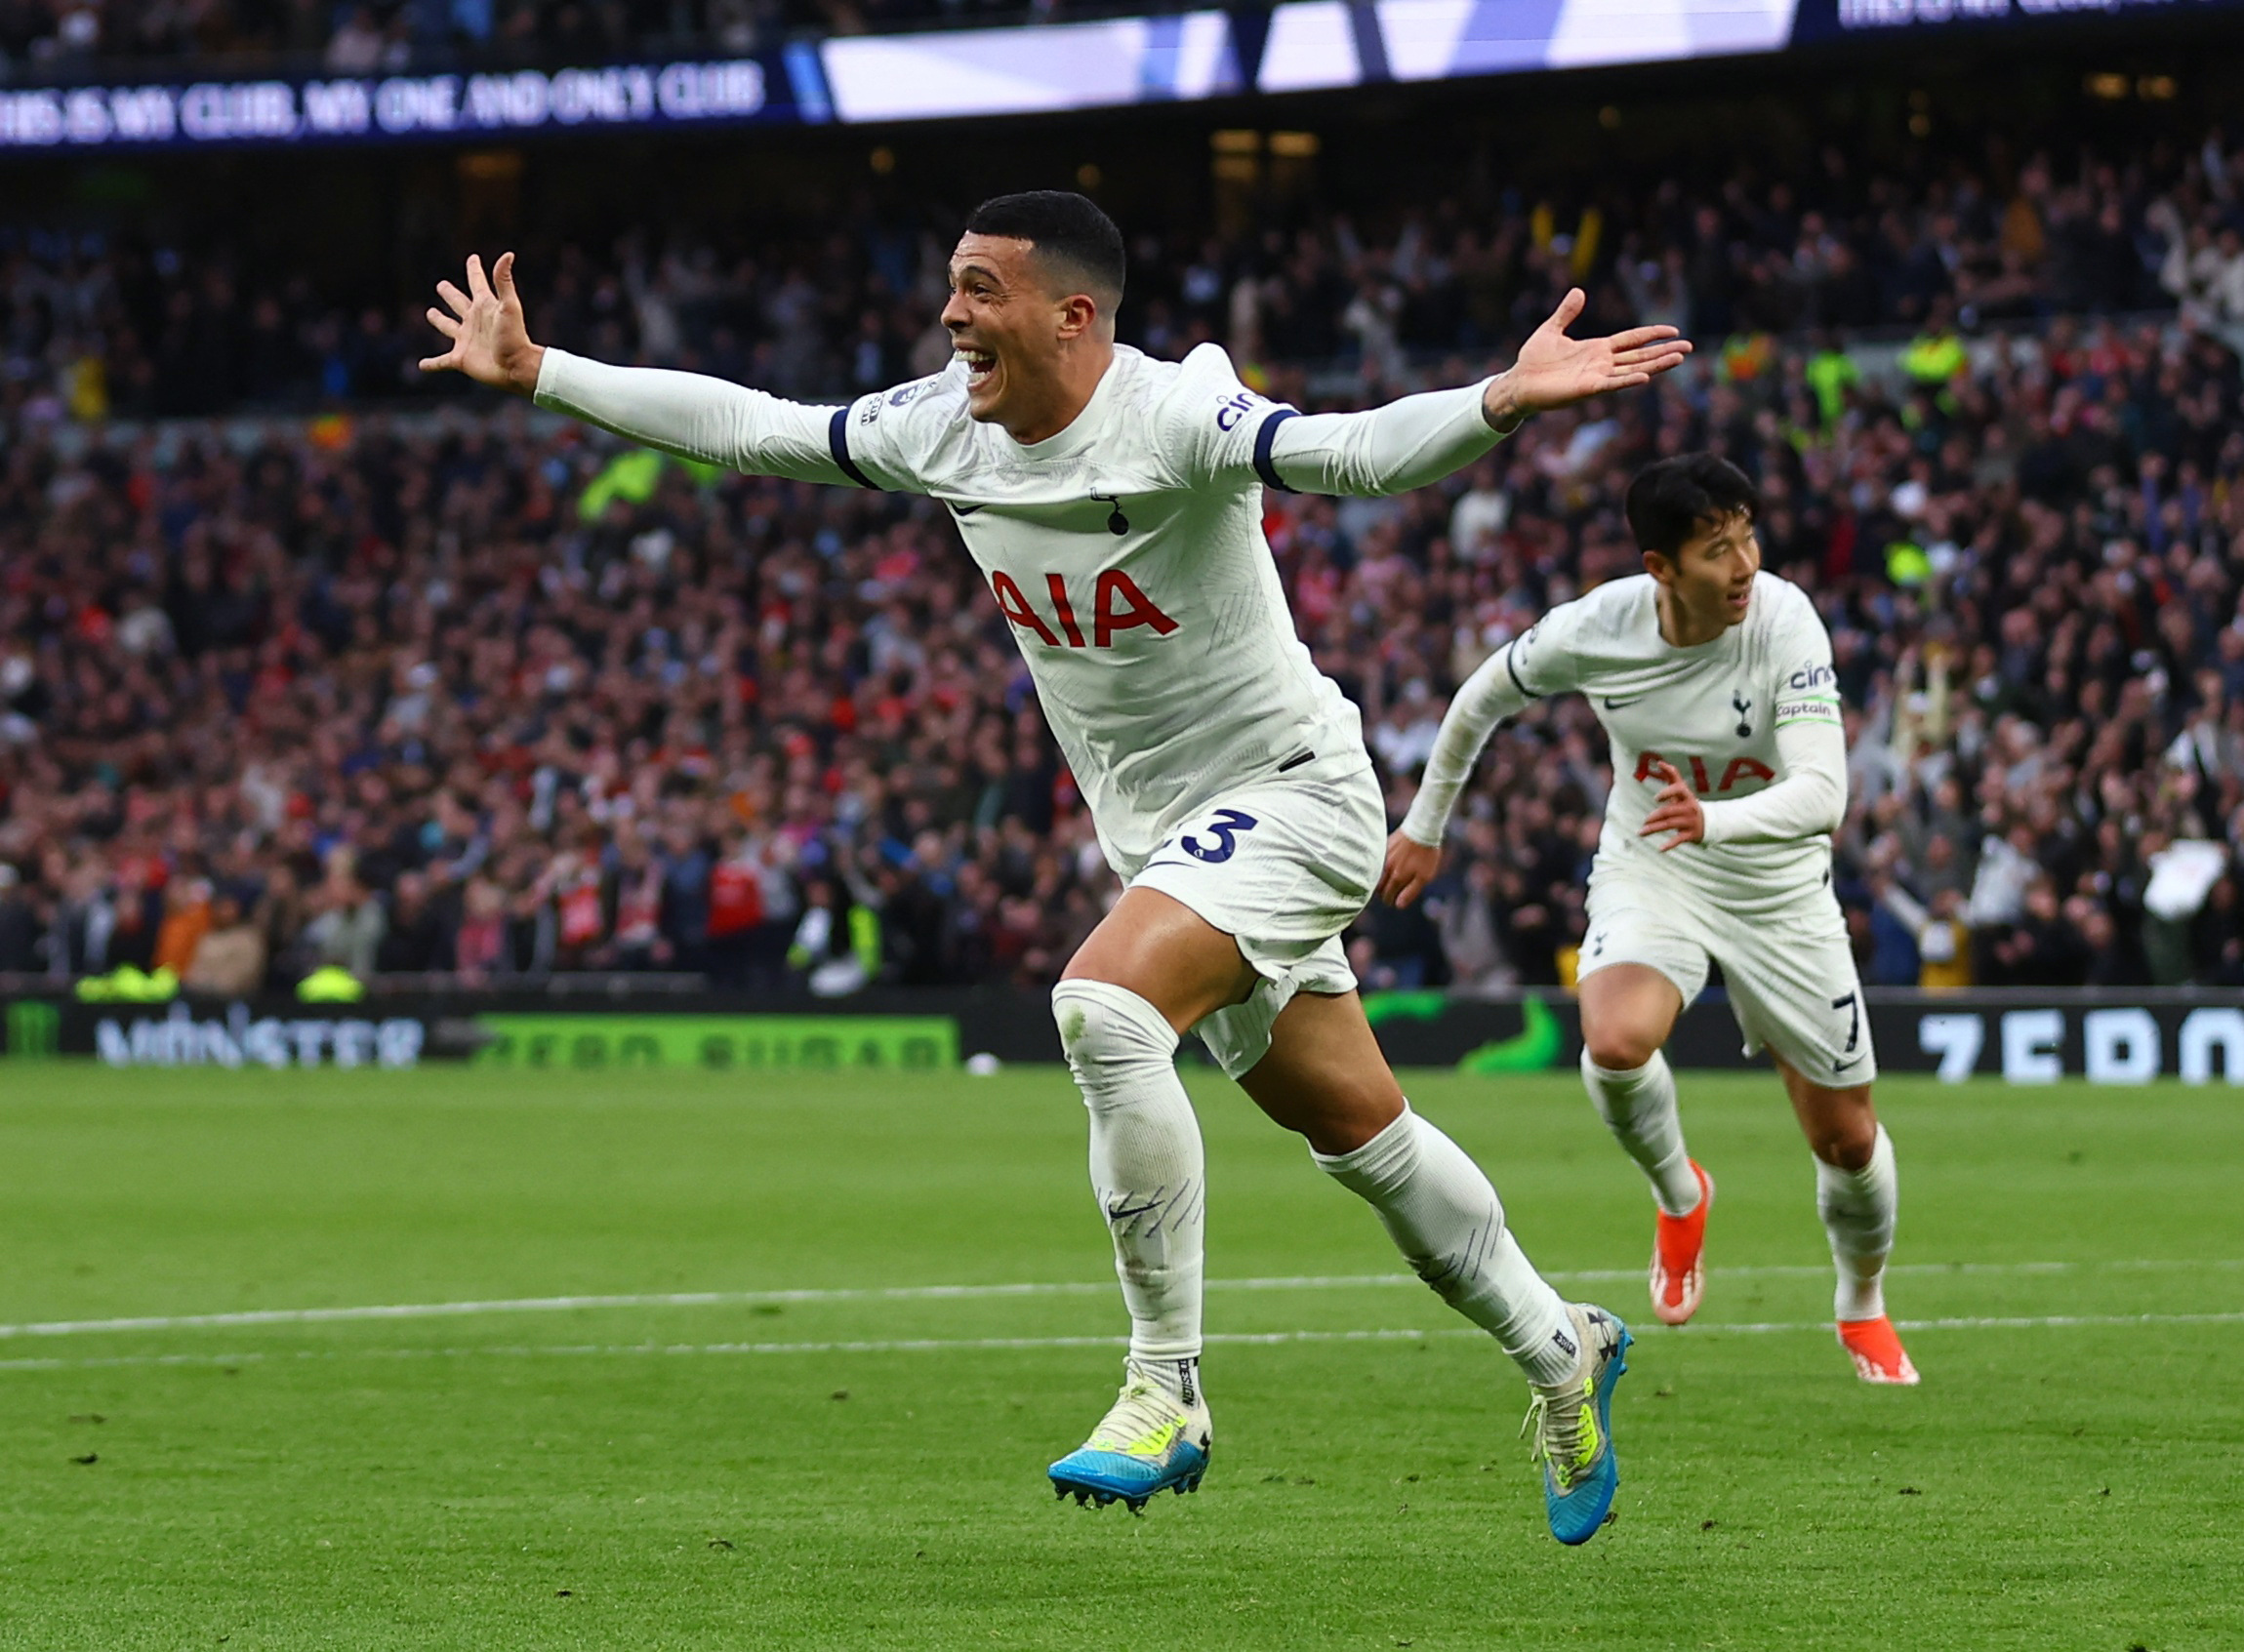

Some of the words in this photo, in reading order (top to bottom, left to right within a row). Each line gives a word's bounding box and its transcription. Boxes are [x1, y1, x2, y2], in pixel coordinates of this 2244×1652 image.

[109, 84, 178, 141] MY
[303, 78, 375, 134] MY
[375, 74, 461, 134] ONE
[461, 69, 551, 128] AND
[550, 65, 656, 125] ONLY
[657, 59, 765, 119] CLUB
[992, 569, 1180, 647] AIA
[1633, 751, 1775, 792] AIA
[1181, 809, 1259, 864] 3
[95, 1000, 425, 1069] MONSTER
[1832, 989, 1858, 1053] 7
